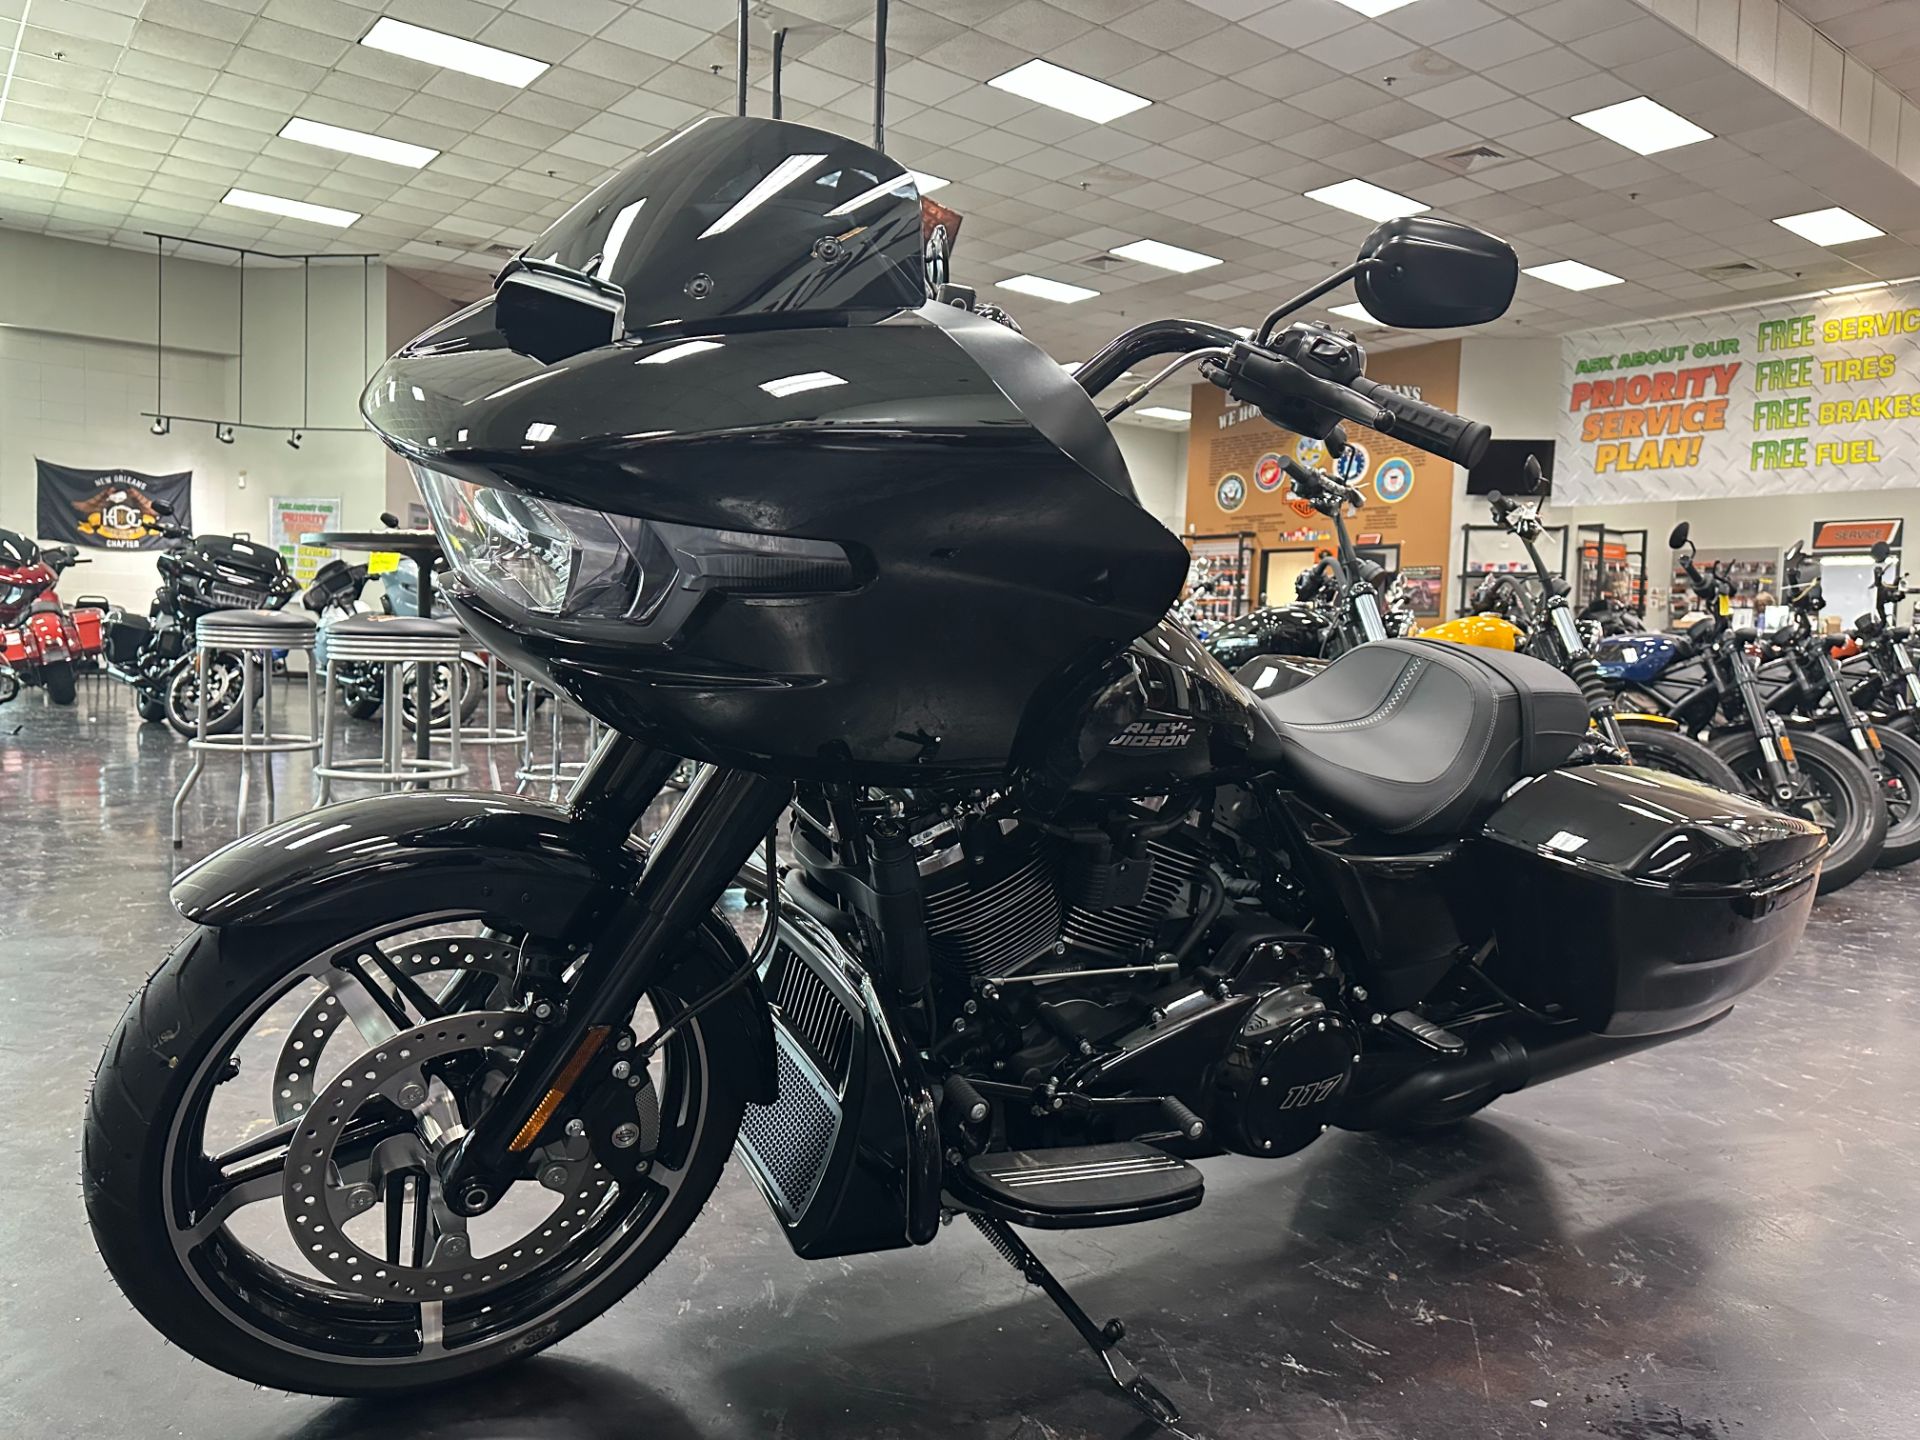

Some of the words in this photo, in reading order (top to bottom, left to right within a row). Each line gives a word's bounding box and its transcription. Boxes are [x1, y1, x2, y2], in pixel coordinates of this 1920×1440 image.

[1757, 315, 1816, 352] FREE
[1823, 308, 1920, 343] SERVIC
[1575, 357, 1613, 375] ASK
[1617, 344, 1688, 370] ABOUT
[1692, 338, 1740, 359] OUR
[1755, 356, 1814, 392] FREE
[1820, 353, 1896, 384] TIRES
[1570, 362, 1742, 412] PRIORITY
[1219, 410, 1236, 430] WE
[1580, 399, 1730, 442] SERVICE
[1753, 397, 1812, 432] FREE
[1817, 393, 1920, 425] BRAKES
[1594, 436, 1704, 473] PLAN!
[1750, 438, 1808, 471] FREE
[1814, 439, 1880, 466] FUEL
[95, 476, 111, 487] NEW
[114, 475, 147, 490] ORLEANS
[106, 539, 140, 548] CHAPTER
[1834, 528, 1882, 540] SERVICE
[1280, 1073, 1343, 1109] 117
